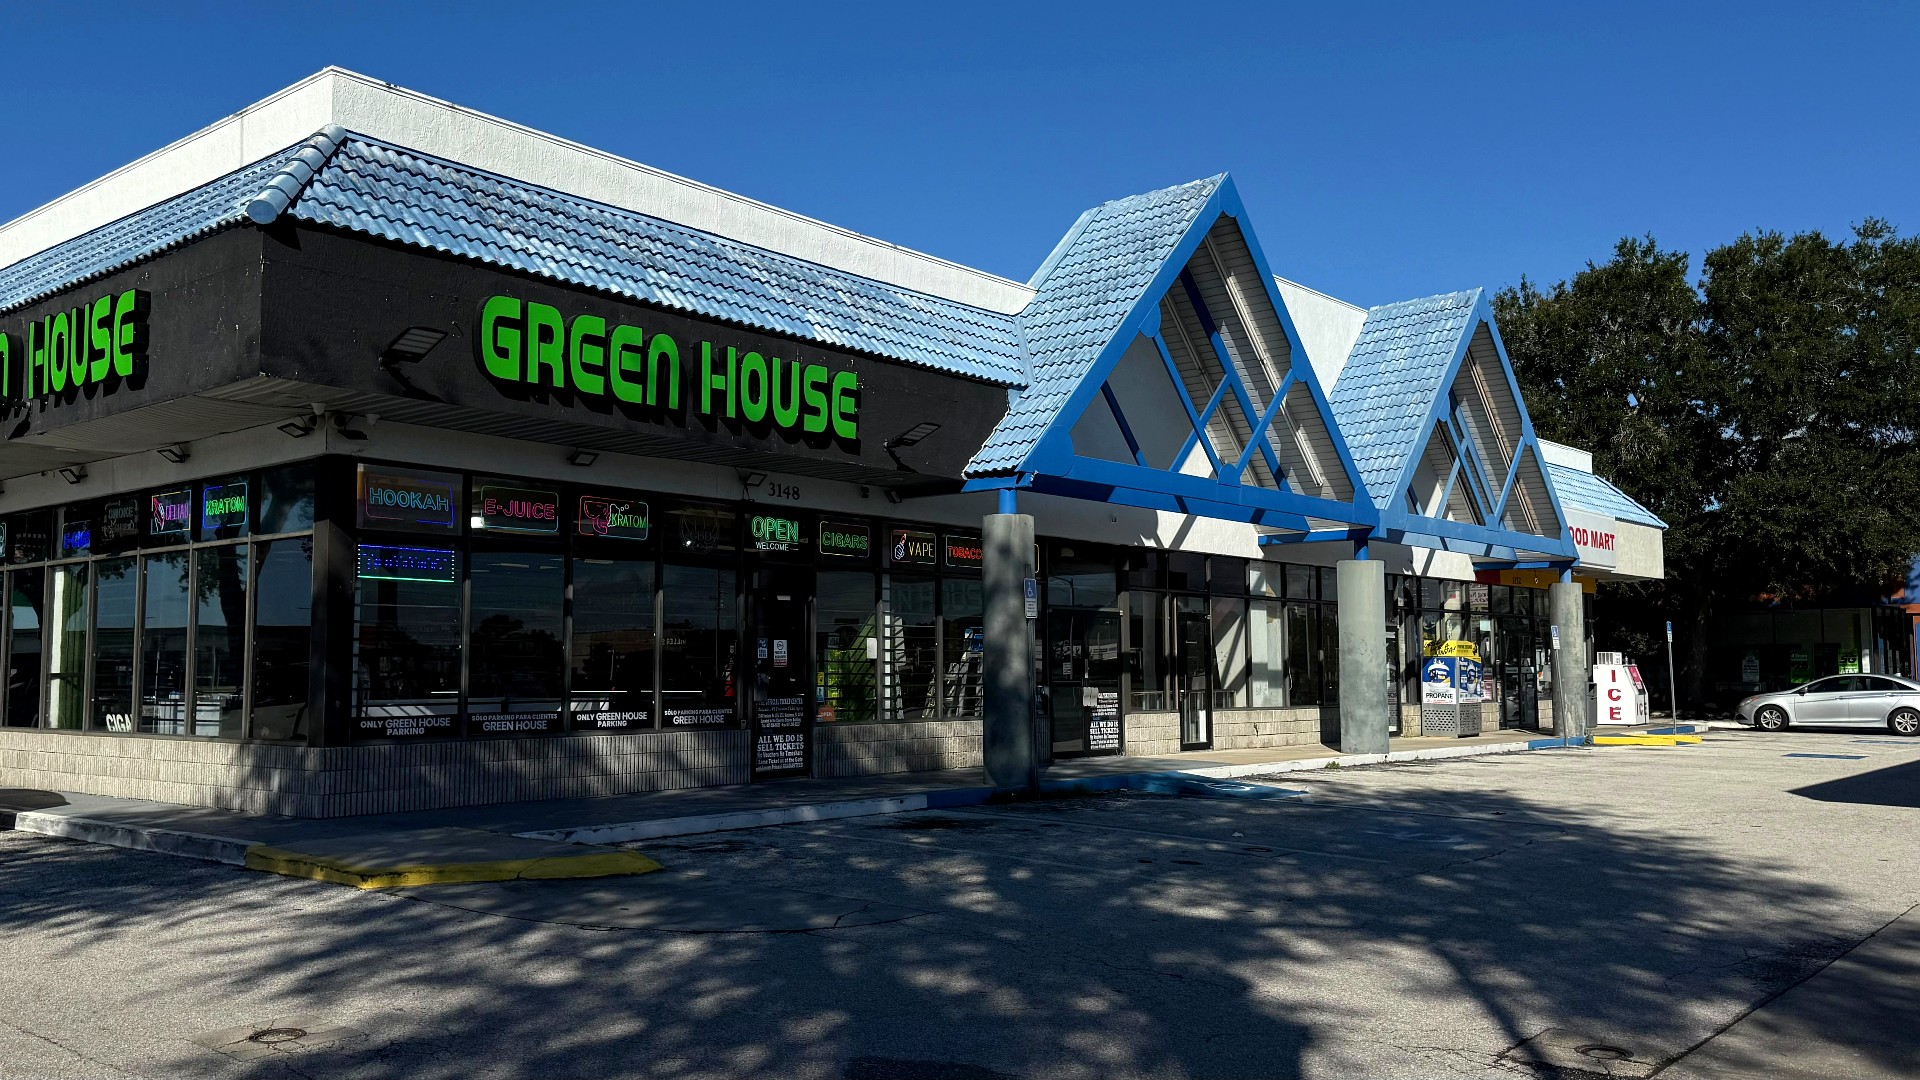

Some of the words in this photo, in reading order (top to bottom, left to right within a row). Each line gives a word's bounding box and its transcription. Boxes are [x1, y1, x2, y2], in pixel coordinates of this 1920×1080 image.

[28, 288, 136, 400] HOUSE
[482, 295, 679, 411] GREEN
[701, 341, 857, 440] HOUSE
[768, 482, 800, 500] 3148
[205, 496, 245, 516] KRATOM
[369, 487, 449, 512] HOOKAH
[484, 498, 556, 520] E-JUICE
[611, 512, 647, 529] KRATOM
[752, 516, 799, 542] OPEN
[755, 541, 790, 551] WELCOME
[822, 533, 868, 549] CIGARS
[1591, 530, 1615, 551] MART
[909, 542, 935, 558] VAPE
[947, 545, 984, 560] TOBACC
[1608, 669, 1622, 721] ICE
[360, 720, 383, 729] ONLY
[385, 718, 416, 728] GREEN
[419, 717, 450, 728] HOUSE
[596, 712, 621, 721] GREEN
[622, 711, 647, 720] HOUSE
[597, 720, 627, 728] PARKING
[673, 715, 698, 725] GREEN
[699, 714, 725, 724] HOUSE
[387, 727, 424, 736] PARKING
[483, 721, 513, 731] GREEN
[515, 720, 547, 730] HOUSE
[757, 744, 774, 752] SELL
[774, 742, 804, 751] TICKETS
[758, 735, 772, 744] ALL
[773, 735, 784, 743] WE
[786, 734, 796, 742] DO
[796, 734, 804, 742] IS
